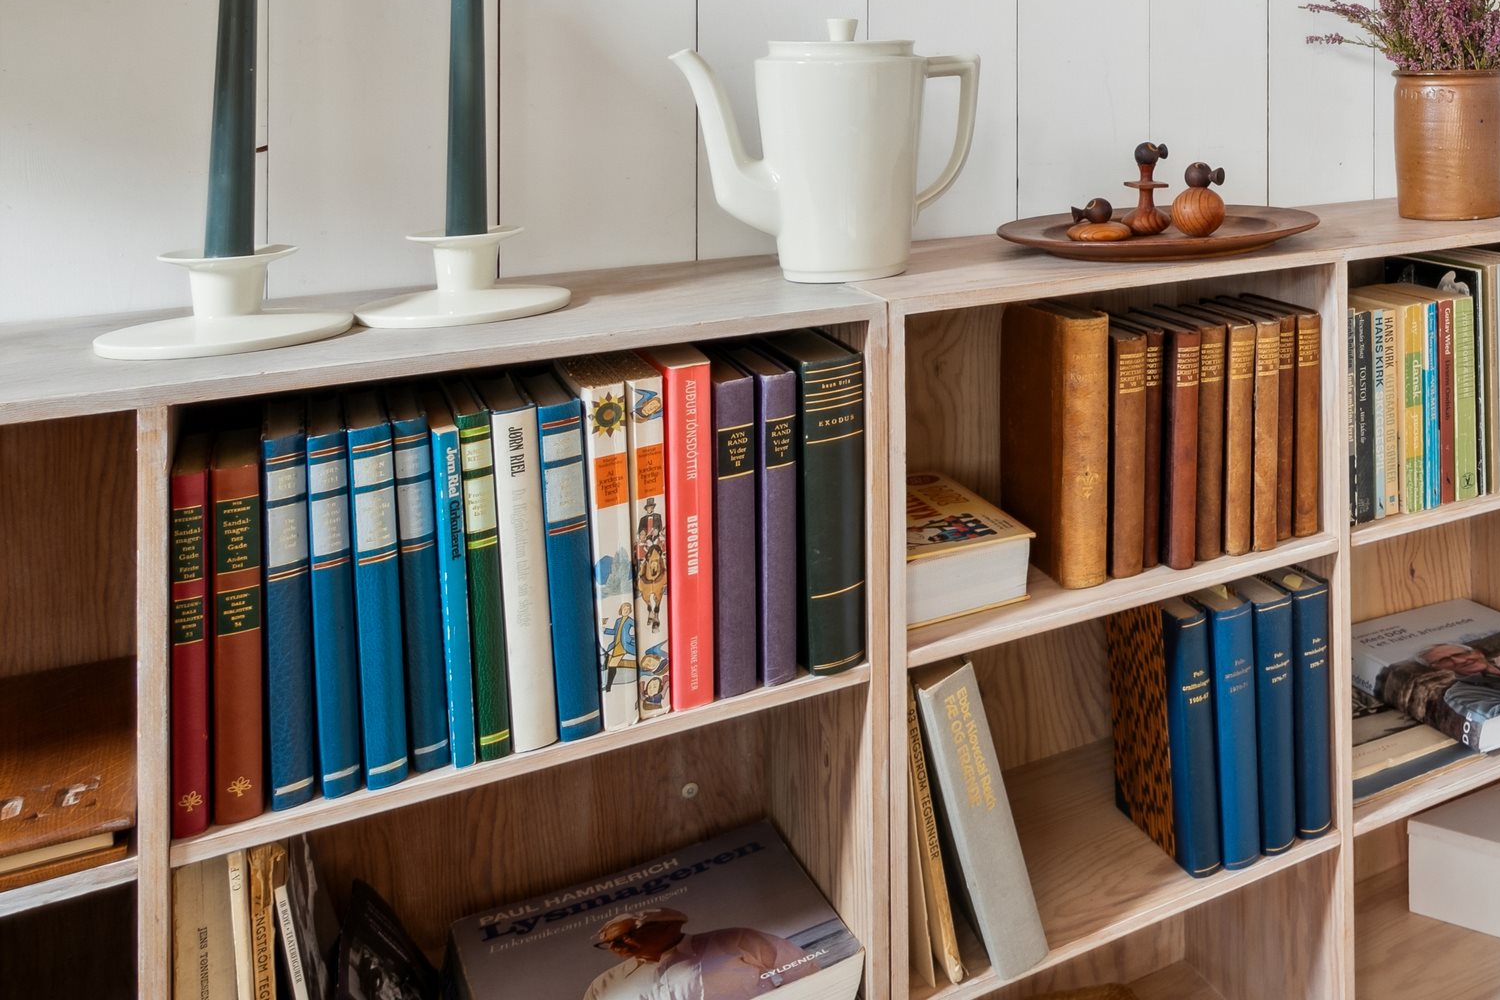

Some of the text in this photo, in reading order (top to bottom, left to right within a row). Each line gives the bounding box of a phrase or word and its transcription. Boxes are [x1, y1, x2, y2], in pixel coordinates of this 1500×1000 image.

[1385, 316, 1394, 343] HANS
[1375, 317, 1384, 388] HANS KIRK
[1444, 334, 1452, 355] Wied
[1385, 346, 1394, 369] KIRK
[1412, 359, 1422, 400] dansk
[774, 422, 789, 431] AYN
[818, 414, 855, 427] EXODUS
[727, 437, 748, 446] RAND
[731, 431, 745, 439] AYN
[771, 429, 792, 438] RAND
[446, 446, 462, 561] Jørn Riel Cirkulæret
[223, 518, 252, 528] Sandal-
[224, 526, 251, 536] mager-
[227, 542, 248, 551] Gade
[231, 535, 244, 543] nes
[687, 515, 698, 577] DEPOSITUM
[179, 552, 199, 561] Gade
[226, 554, 248, 563] Anden
[690, 635, 698, 692] TIDERNE SKIFTER
[957, 686, 972, 721] Ebbe
[951, 720, 965, 744] OG
[1462, 711, 1473, 746] DOF
[921, 795, 940, 861] TEGNINGER
[478, 841, 766, 943] Lysmageren
[479, 857, 679, 927] PAUL HAMMERICH
[281, 909, 290, 927] BOYE
[286, 931, 302, 984] TEATERFIGURER
[760, 948, 829, 981] GYLDENDAL
